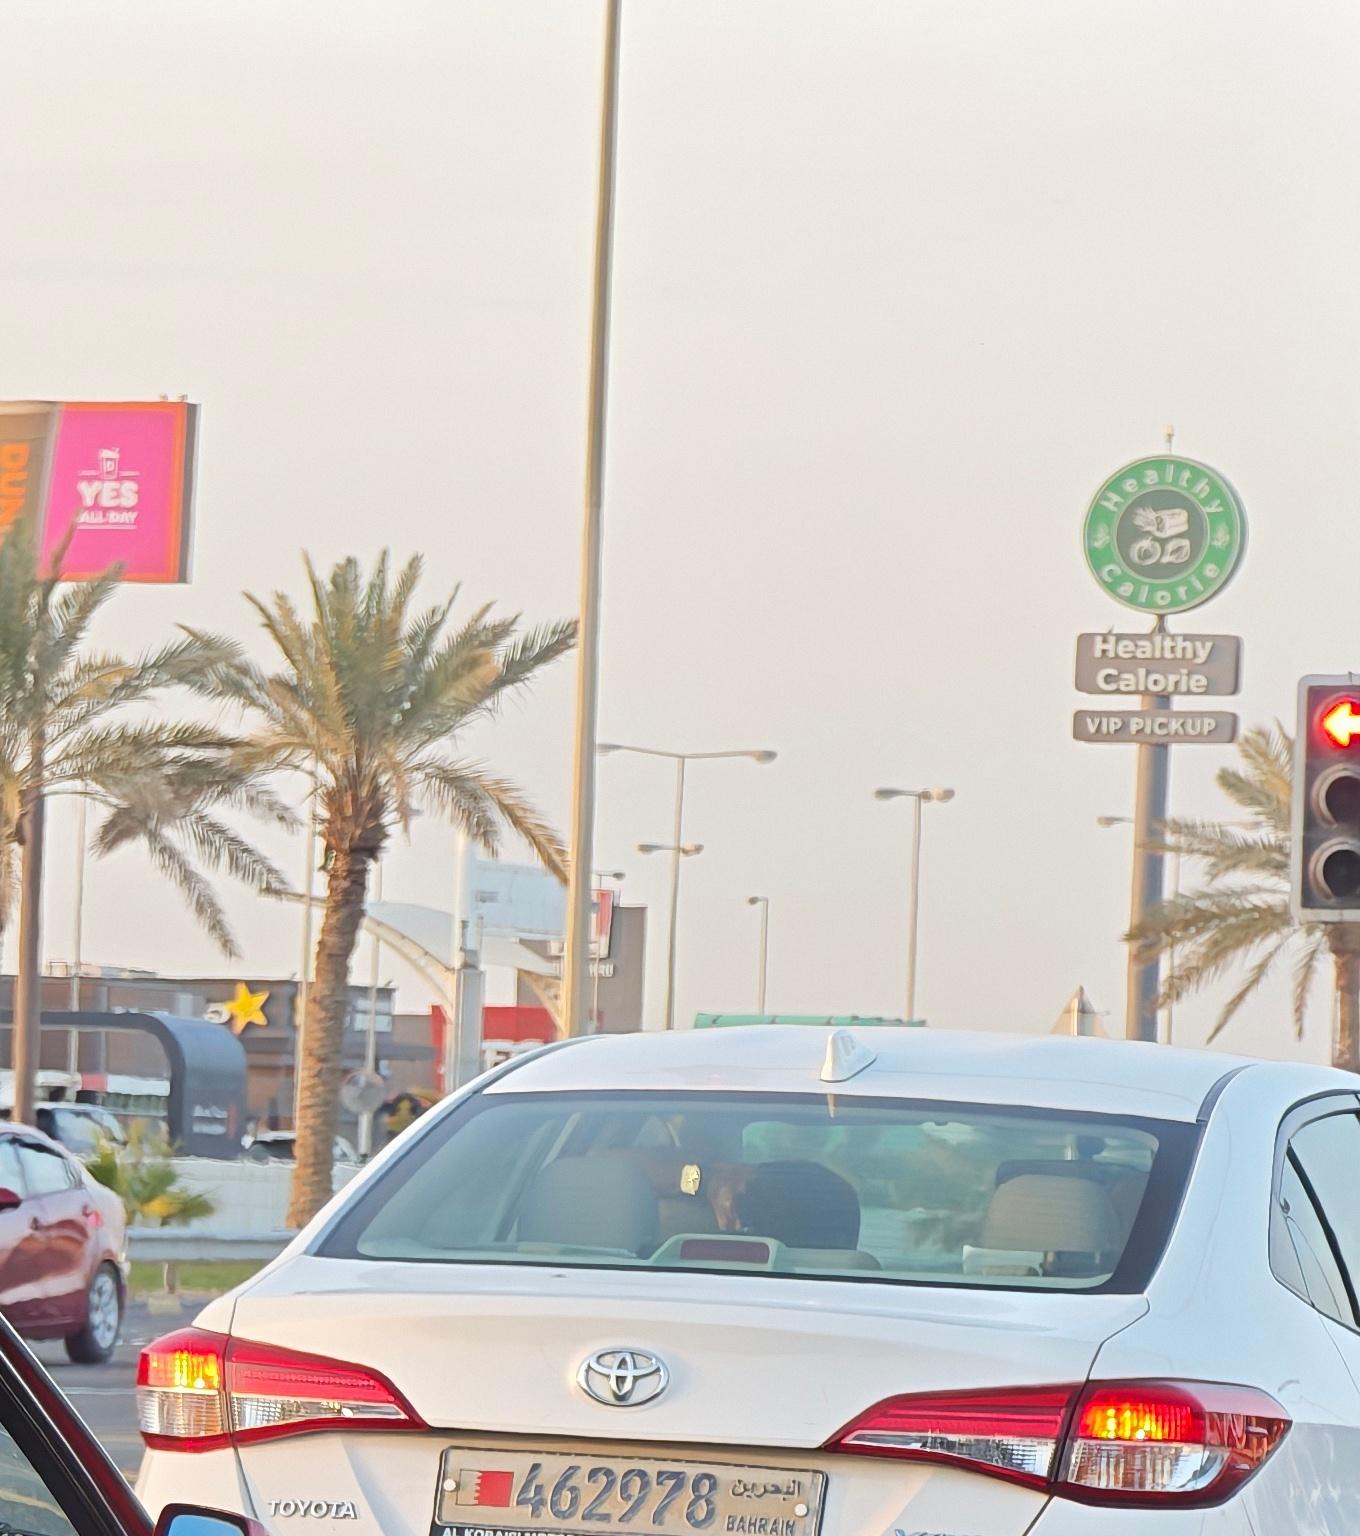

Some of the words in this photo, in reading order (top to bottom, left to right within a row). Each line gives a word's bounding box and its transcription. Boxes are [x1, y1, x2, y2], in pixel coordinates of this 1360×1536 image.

[77, 480, 138, 508] YES
[1099, 463, 1224, 514] Healthy
[107, 510, 138, 524] DAY
[1099, 562, 1220, 606] Calorie
[1093, 635, 1214, 664] Healthy
[1096, 667, 1208, 693] Calorie
[1085, 716, 1122, 735] VIP
[1131, 716, 1216, 737] PICKUP
[516, 1463, 718, 1530] 462978
[730, 1479, 801, 1502] البحرين
[267, 1499, 358, 1520] TOYOTA
[726, 1515, 796, 1536] BAHRAIN
